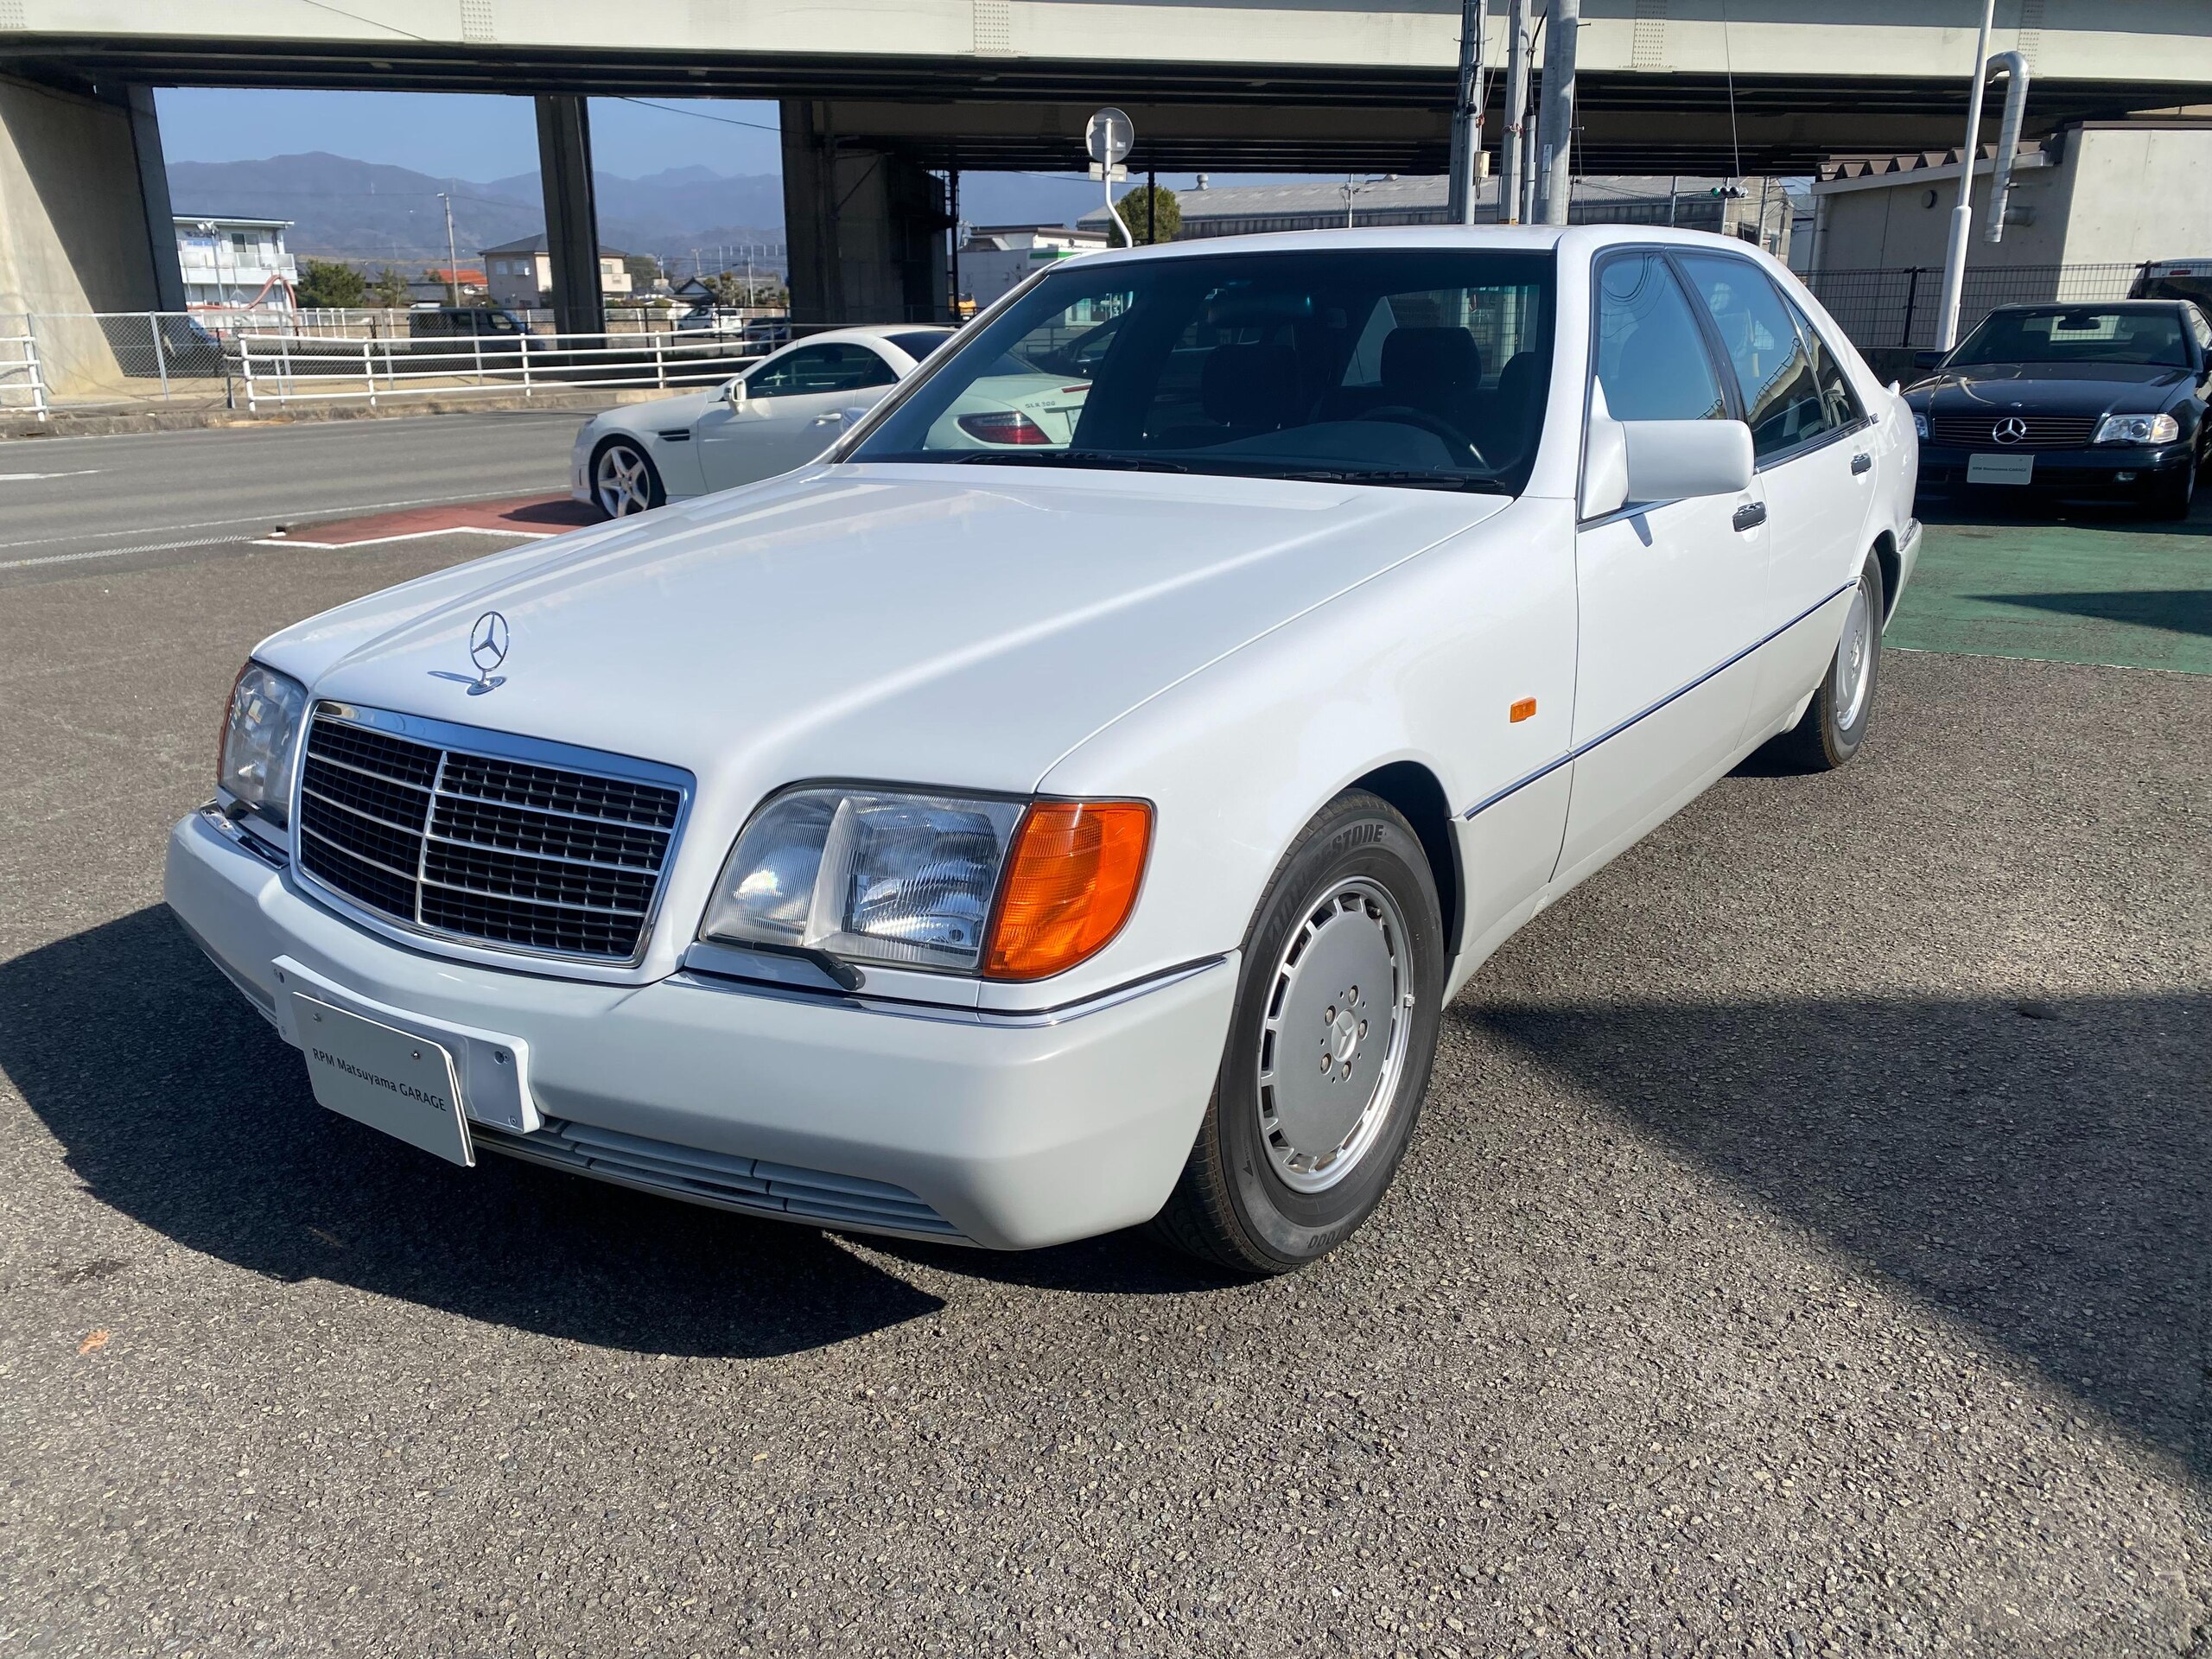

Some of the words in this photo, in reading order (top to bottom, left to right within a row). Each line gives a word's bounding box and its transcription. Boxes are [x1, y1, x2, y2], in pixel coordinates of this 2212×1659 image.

[312, 1047, 335, 1067] RPM
[337, 1058, 397, 1092] Matsuyama
[399, 1083, 447, 1111] GARAGE
